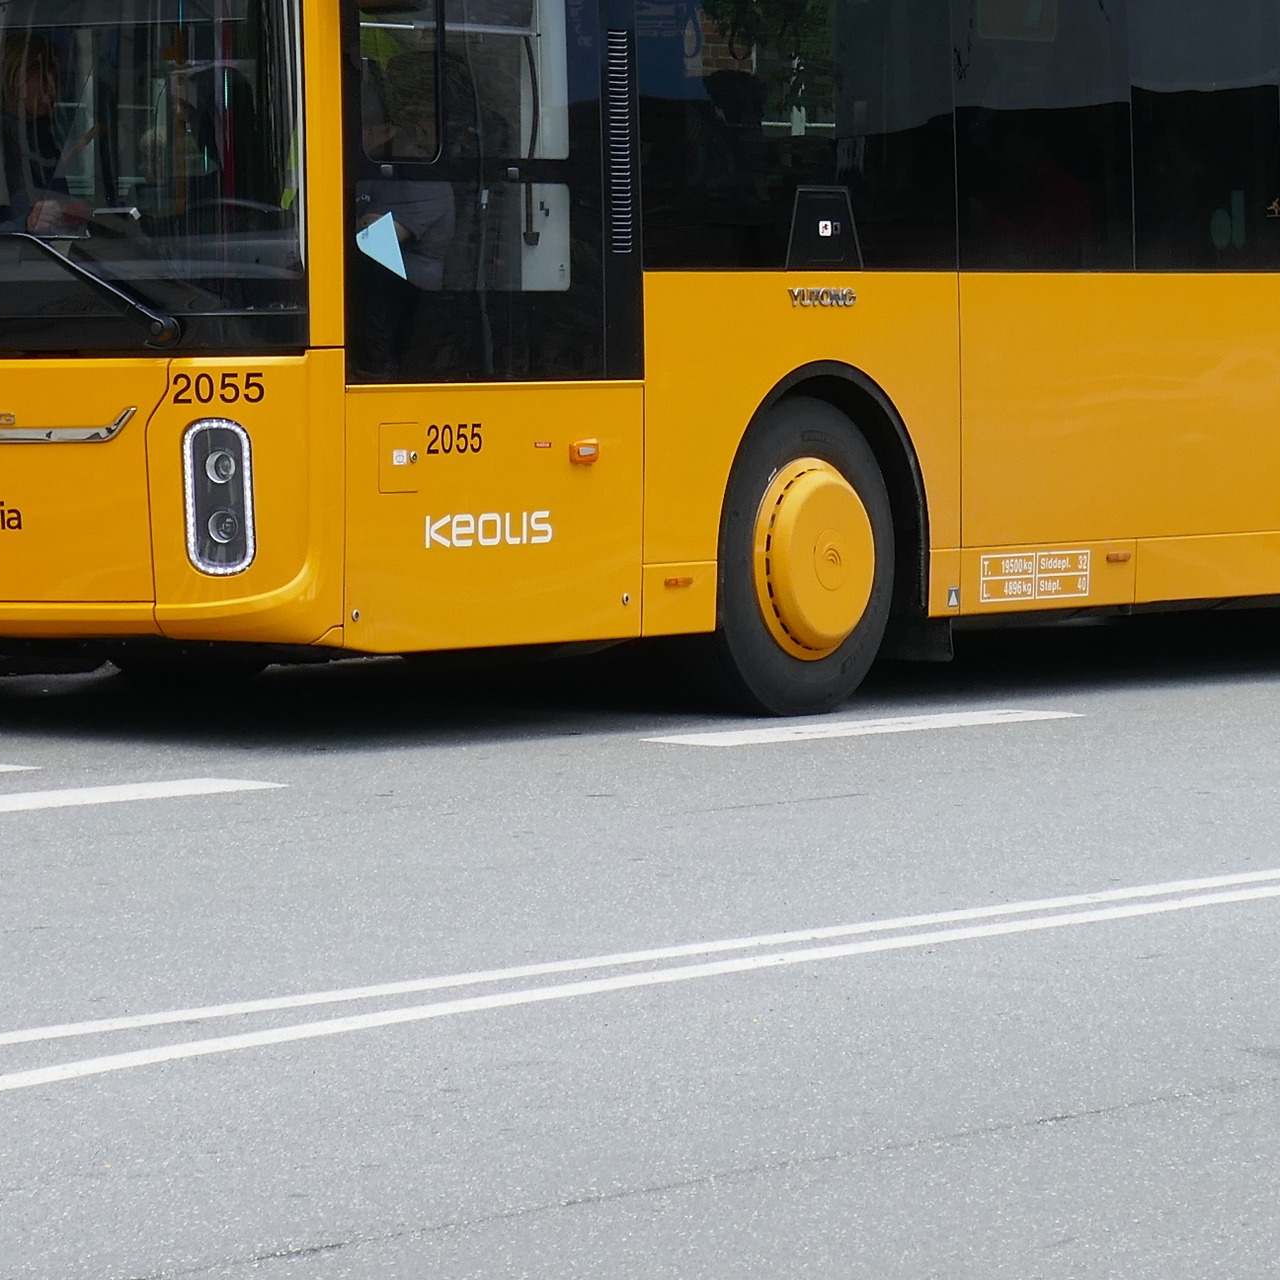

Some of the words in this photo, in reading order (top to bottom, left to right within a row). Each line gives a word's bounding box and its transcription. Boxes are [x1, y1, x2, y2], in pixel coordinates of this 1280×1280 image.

[788, 288, 856, 307] YUTONG
[172, 372, 265, 404] 2055
[426, 423, 483, 455] 2055
[983, 561, 992, 575] T.
[1040, 557, 1071, 570] Siddepl.
[1078, 554, 1087, 569] 32
[1077, 577, 1087, 591] 40
